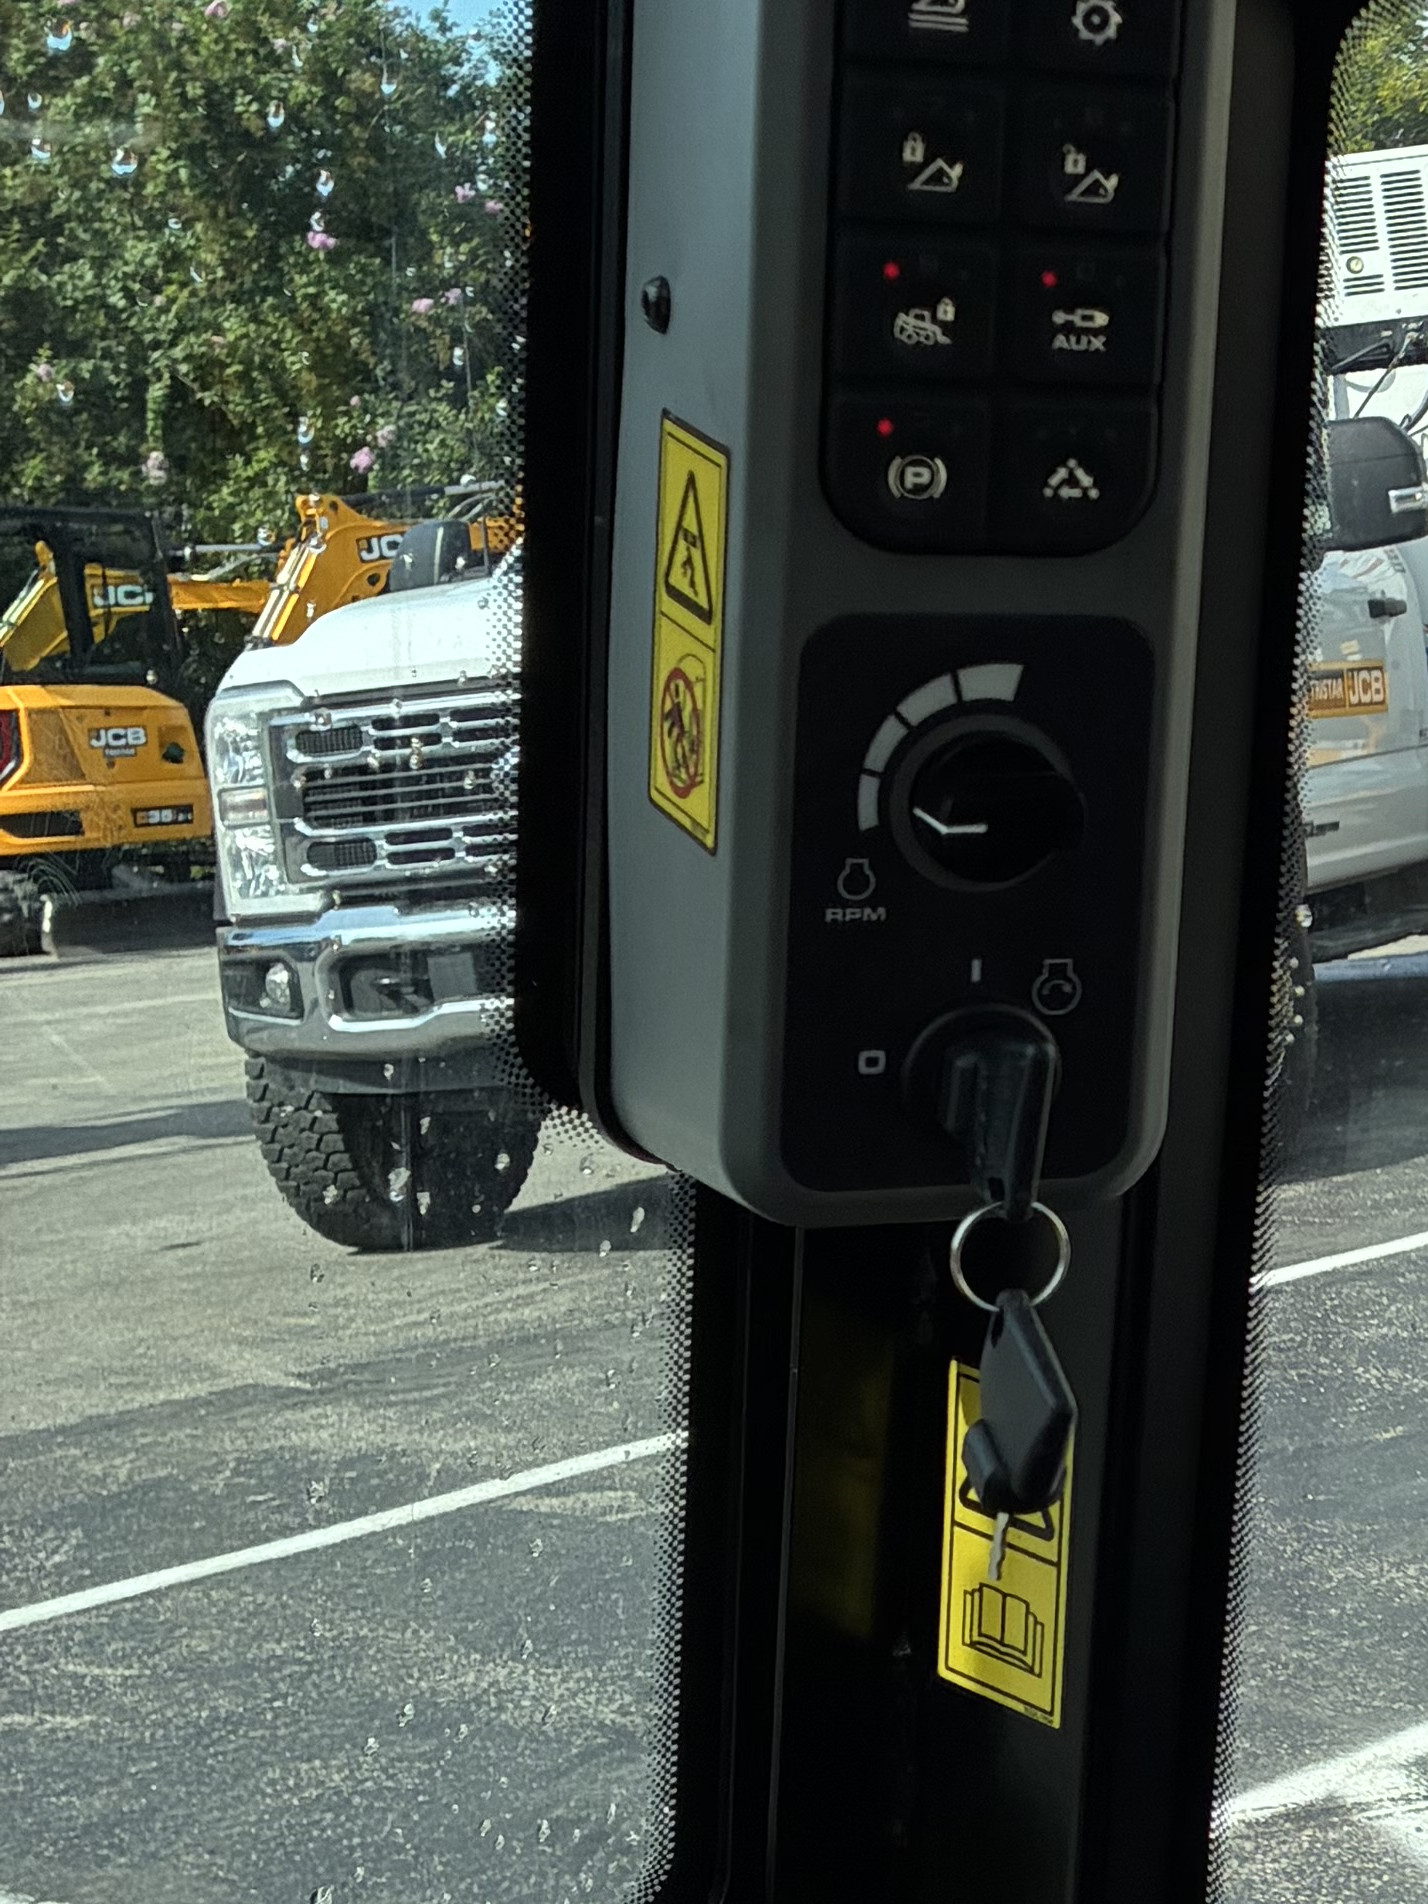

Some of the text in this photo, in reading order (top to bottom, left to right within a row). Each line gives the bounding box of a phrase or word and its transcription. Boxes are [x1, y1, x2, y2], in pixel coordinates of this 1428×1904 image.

[1051, 333, 1107, 353] AUX
[360, 534, 405, 561] JC
[1348, 669, 1385, 705] JCB
[89, 726, 147, 748] JCB
[825, 906, 888, 923] RPM
